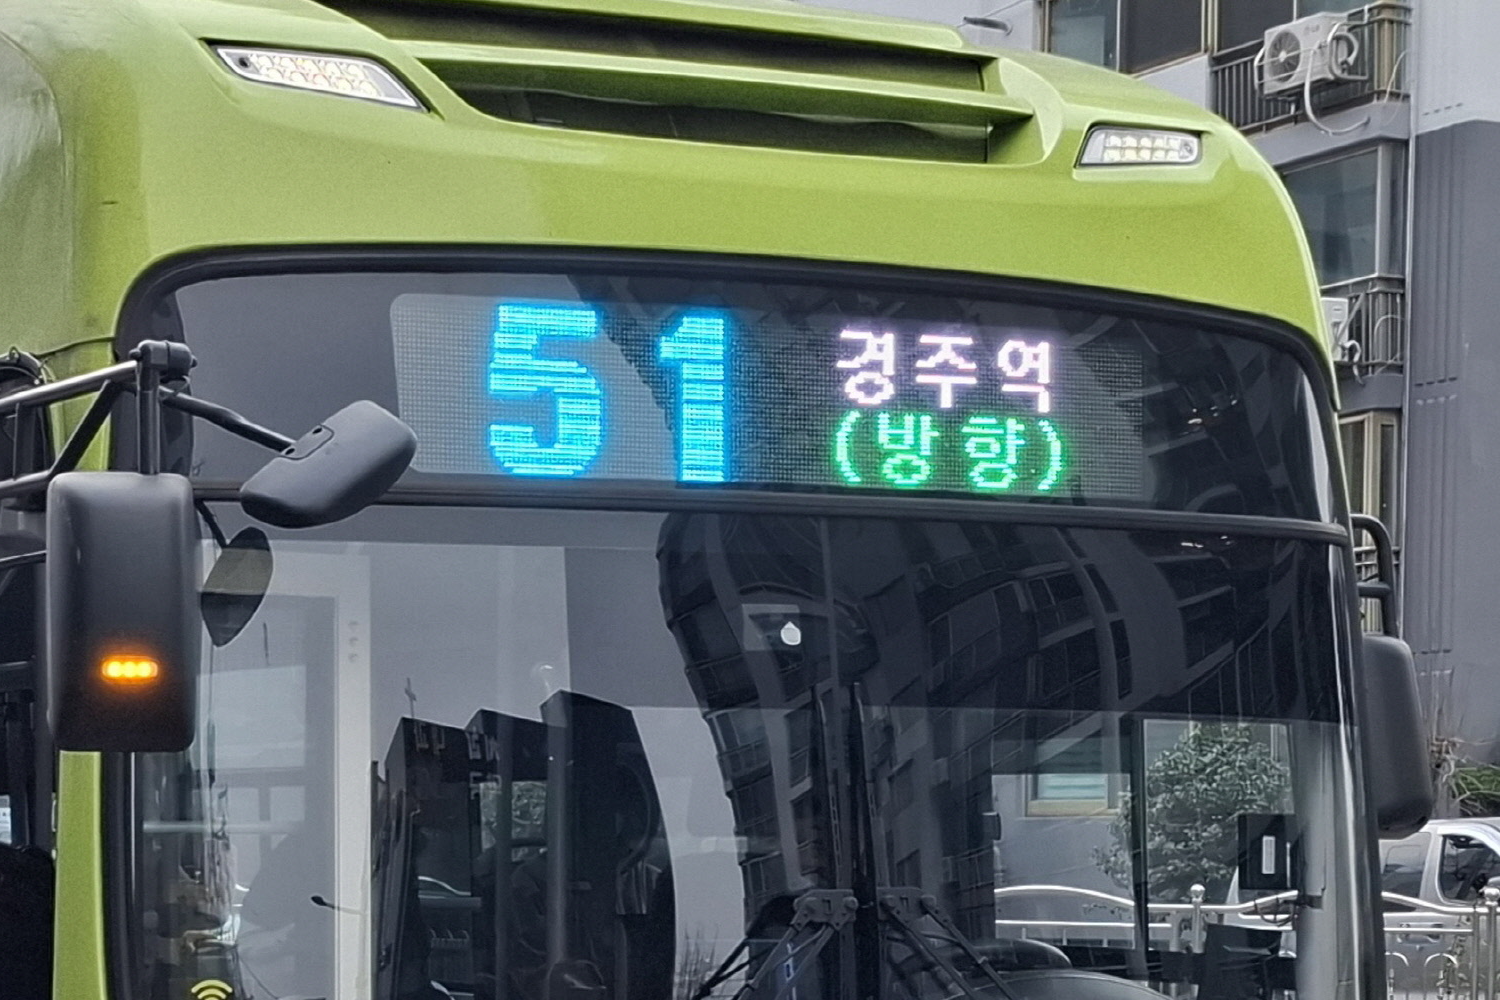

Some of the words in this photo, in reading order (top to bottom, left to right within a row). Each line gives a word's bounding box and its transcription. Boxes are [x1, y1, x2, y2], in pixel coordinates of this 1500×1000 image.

[488, 303, 727, 483] 51
[836, 328, 1052, 413] 경주역
[835, 410, 1066, 491] (방향)
